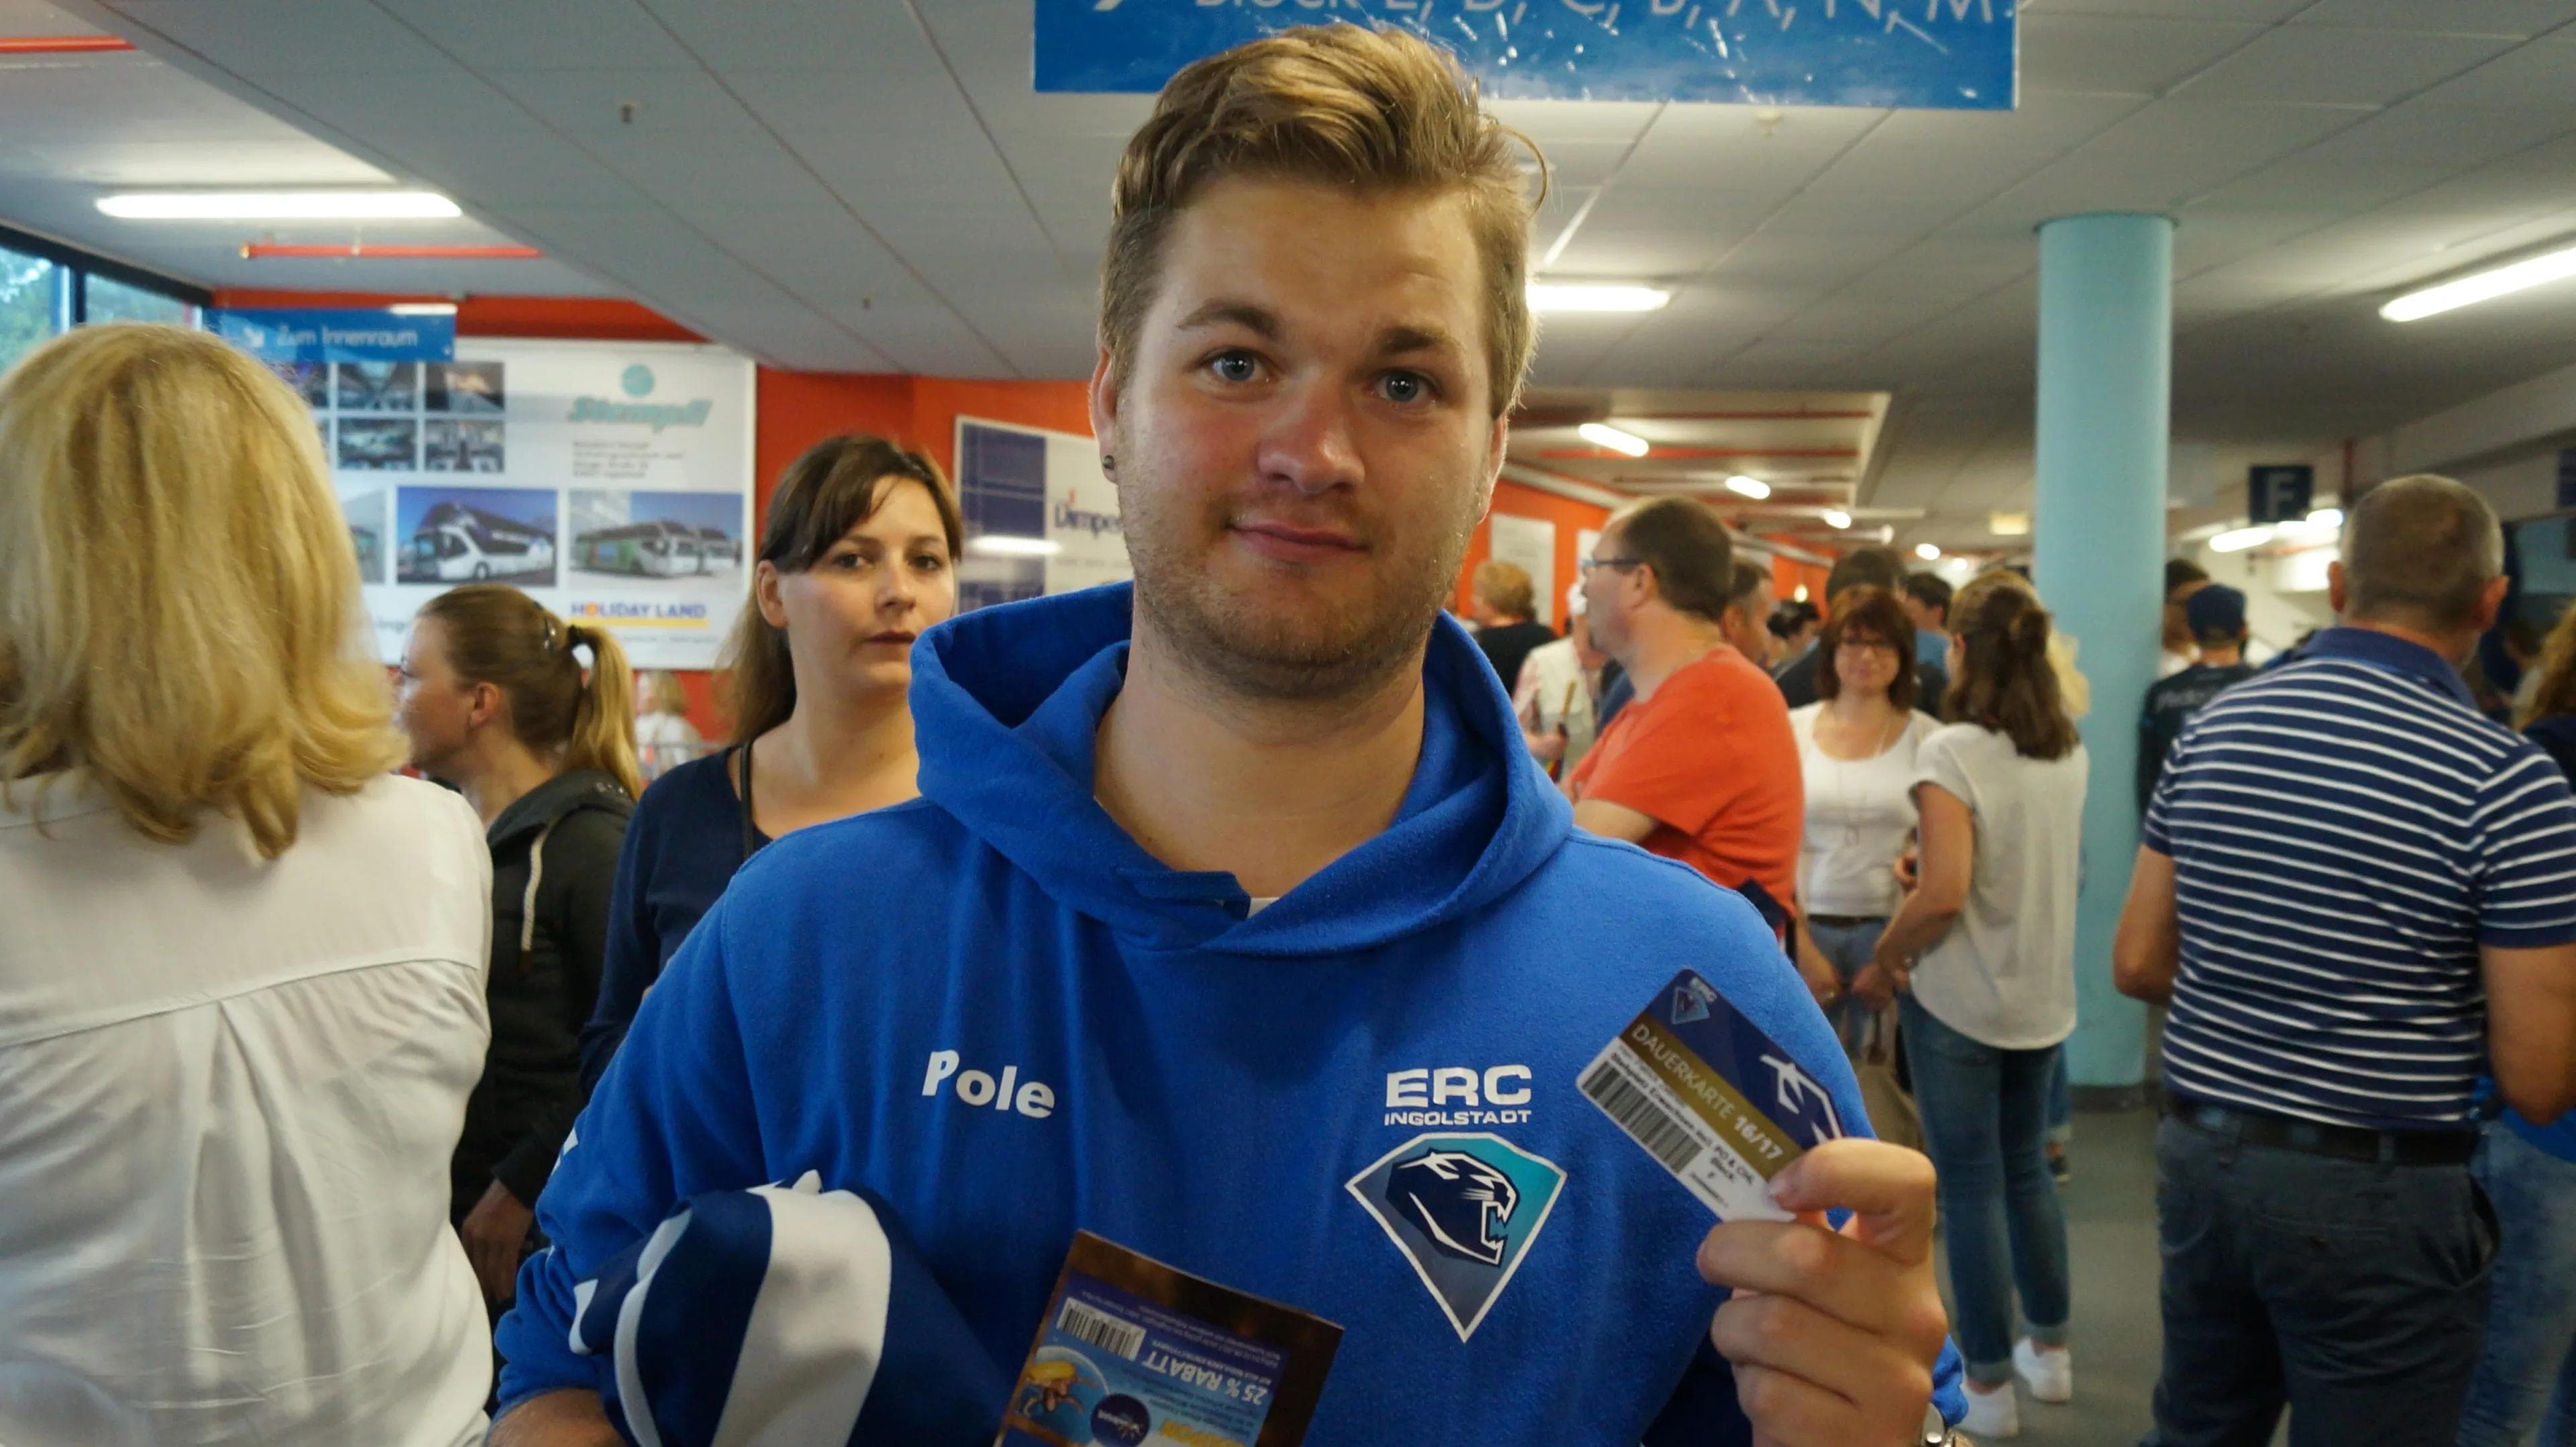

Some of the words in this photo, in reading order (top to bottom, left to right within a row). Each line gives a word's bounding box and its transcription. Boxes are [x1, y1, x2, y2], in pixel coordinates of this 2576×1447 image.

[321, 323, 418, 347] Innenraum
[2265, 472, 2295, 518] F
[572, 602, 651, 618] HOLIDAY
[656, 603, 706, 619] LAND
[922, 1049, 1055, 1119] Pole
[1386, 1064, 1533, 1108] ERC
[1631, 1024, 1735, 1120] DAUERKARTE
[1733, 1115, 1784, 1160] 16/17
[1384, 1110, 1532, 1126] INGOLSTADT
[1141, 1350, 1224, 1392] RABATT
[1225, 1377, 1241, 1398] %
[1242, 1384, 1269, 1406] 25
